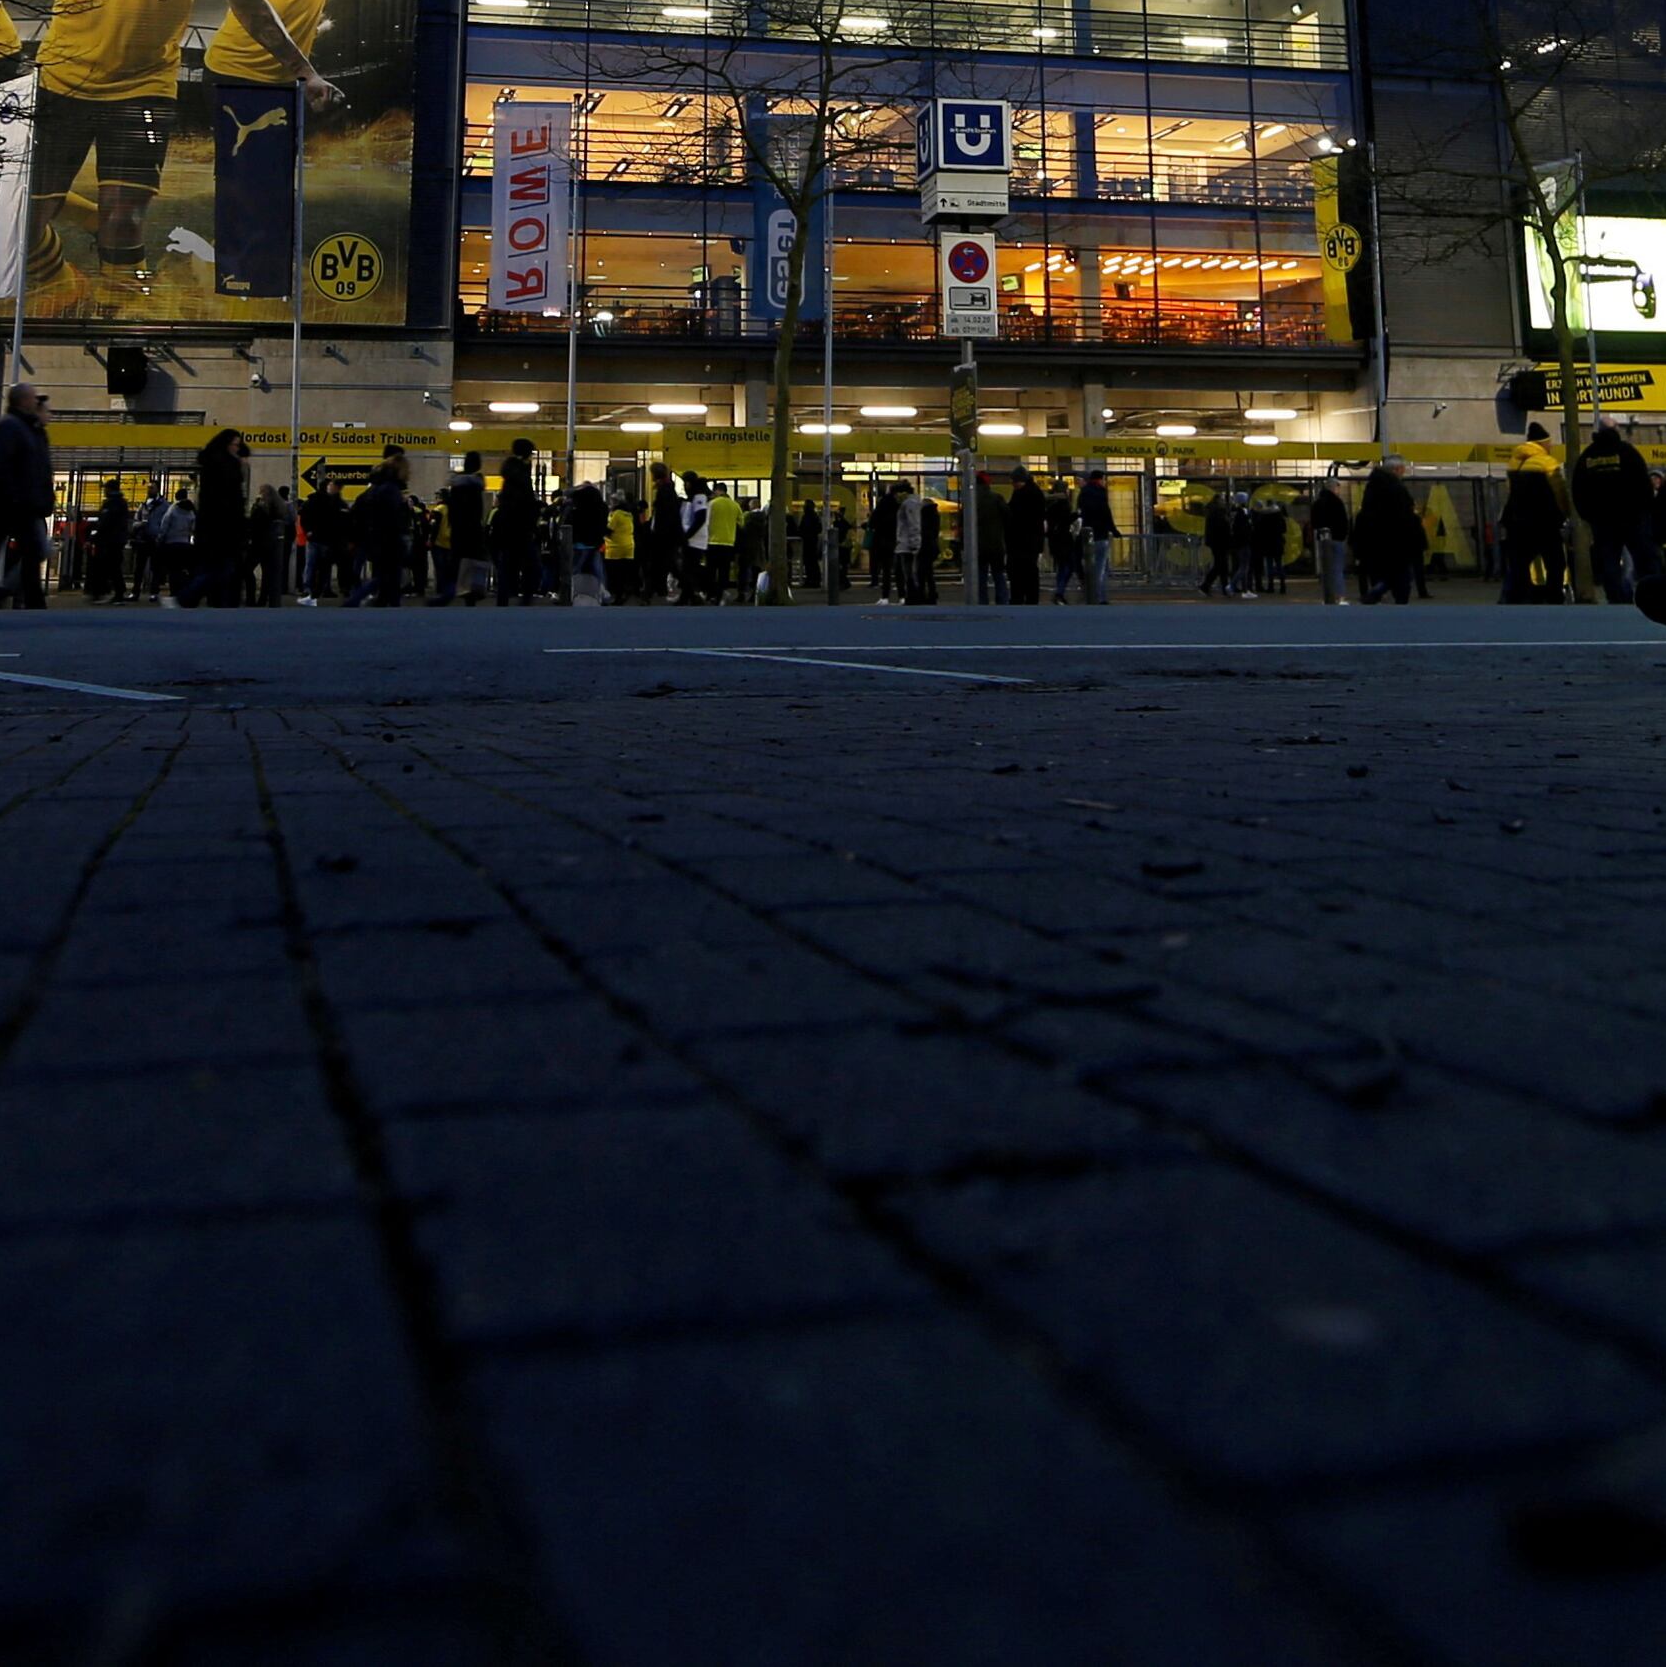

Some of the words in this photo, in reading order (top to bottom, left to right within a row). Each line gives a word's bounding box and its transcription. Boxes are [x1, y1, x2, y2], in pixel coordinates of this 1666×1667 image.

[967, 199, 1006, 207] Stadtmitte
[321, 241, 375, 281] BVB
[336, 282, 355, 295] 09
[1546, 391, 1560, 405] IN
[299, 432, 320, 444] Ost
[685, 430, 771, 443] Clearingstelle
